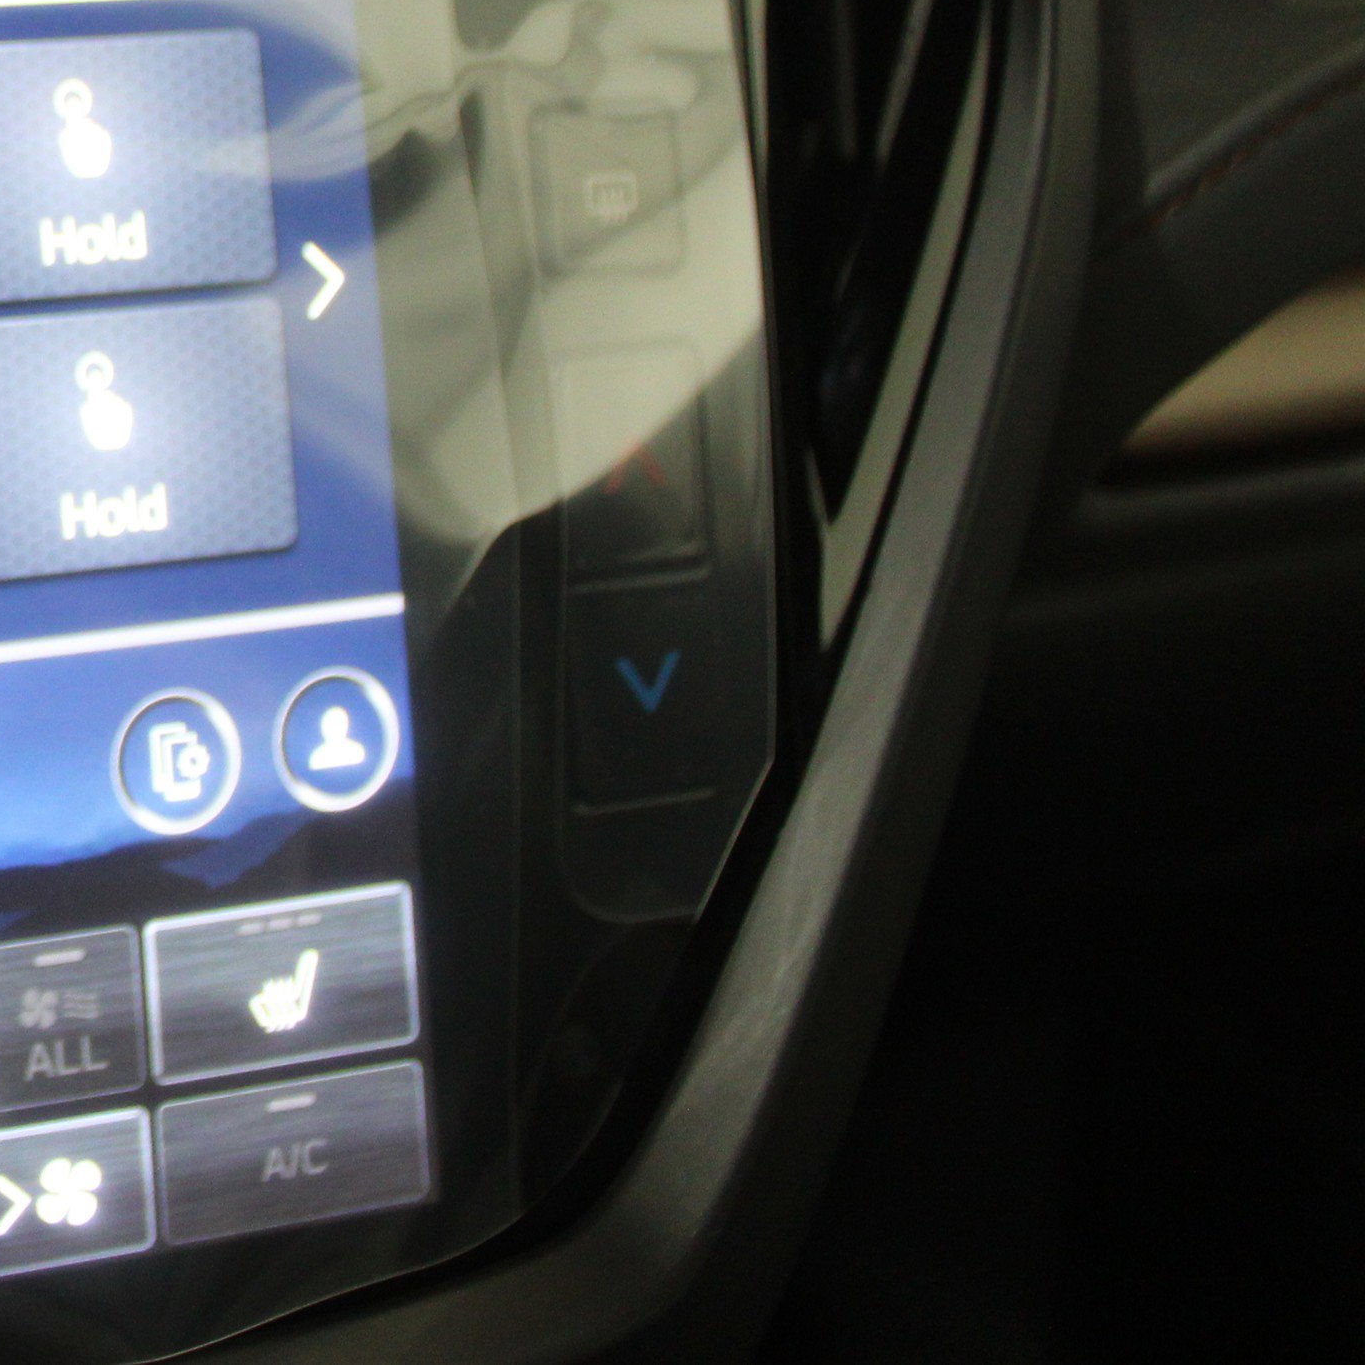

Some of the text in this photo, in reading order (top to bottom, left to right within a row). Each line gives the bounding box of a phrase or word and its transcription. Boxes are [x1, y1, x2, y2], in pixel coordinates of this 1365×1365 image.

[39, 211, 148, 266] Hold
[60, 483, 170, 540] Hold
[24, 1042, 110, 1081] ALL
[261, 1138, 329, 1183] A/C
